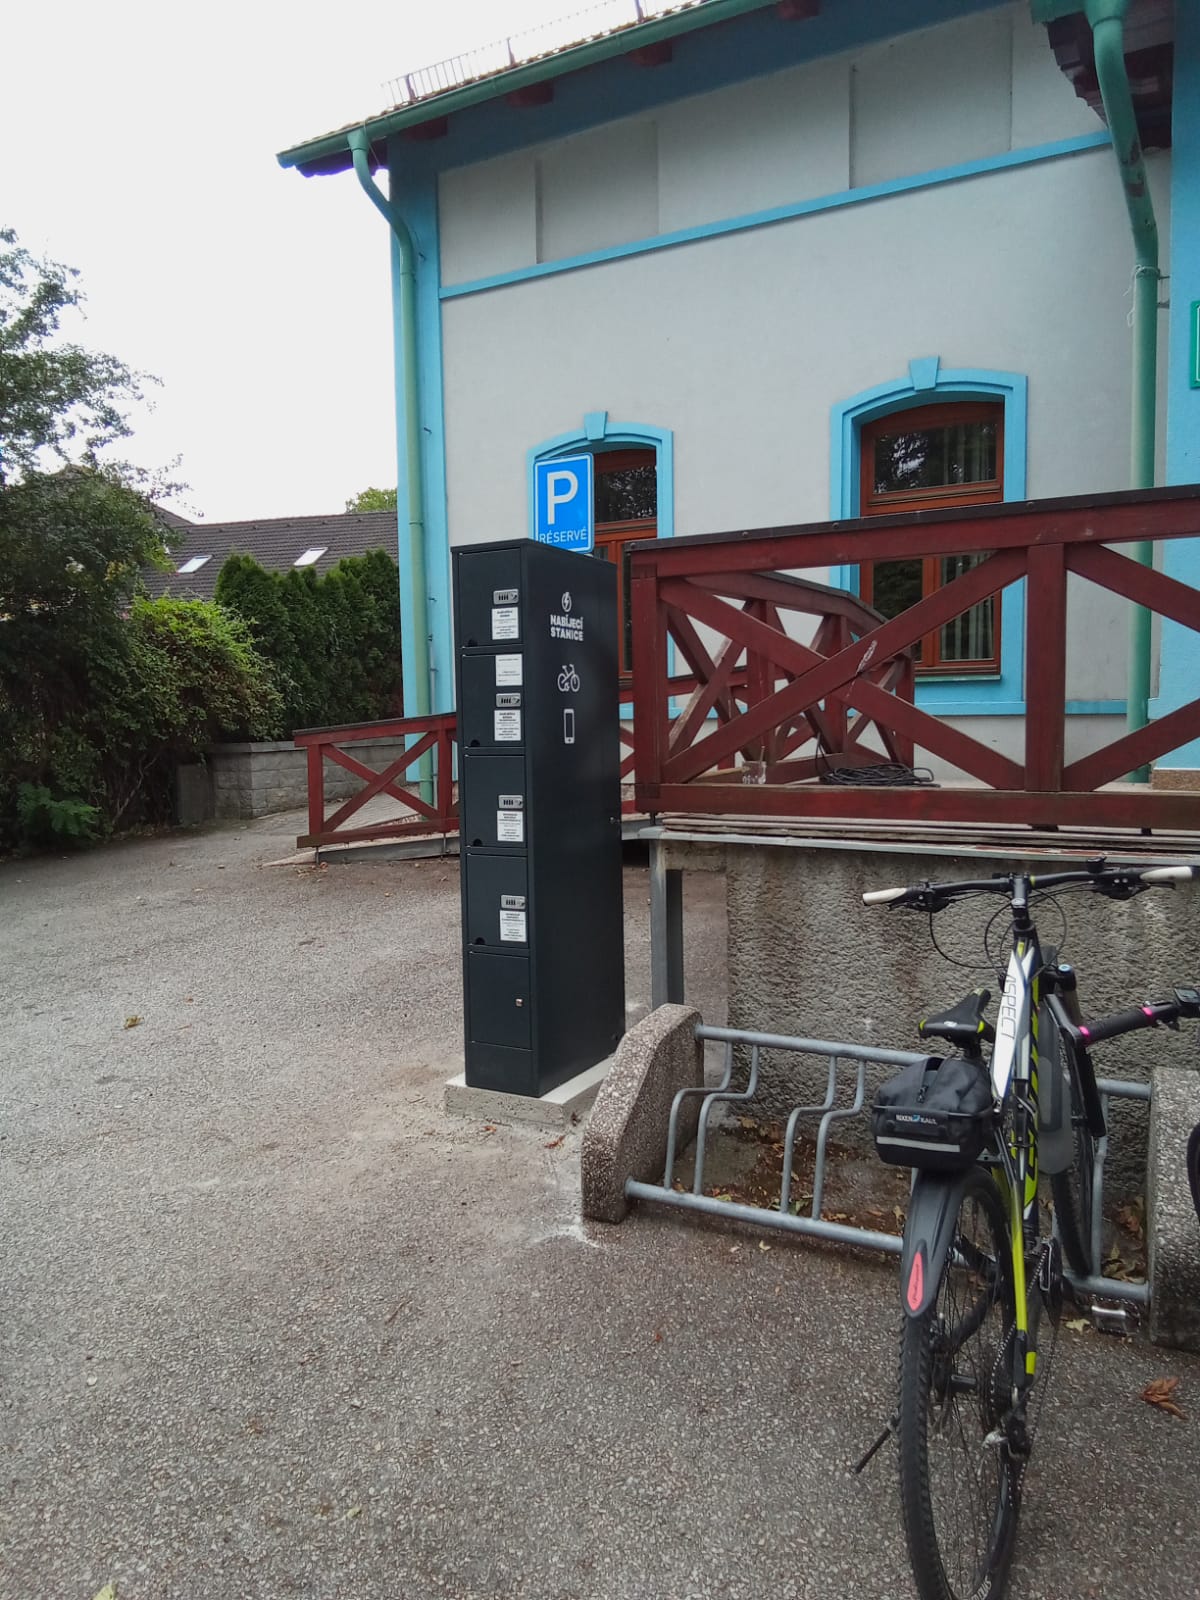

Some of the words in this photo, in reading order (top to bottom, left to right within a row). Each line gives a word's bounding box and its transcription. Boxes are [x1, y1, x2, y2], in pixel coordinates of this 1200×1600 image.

[547, 470, 579, 525] P
[539, 526, 587, 544] RÉSERVÉ
[550, 614, 584, 630] NABÍJECÍ
[550, 626, 584, 641] STANICE
[1001, 974, 1017, 1040] ASPECT
